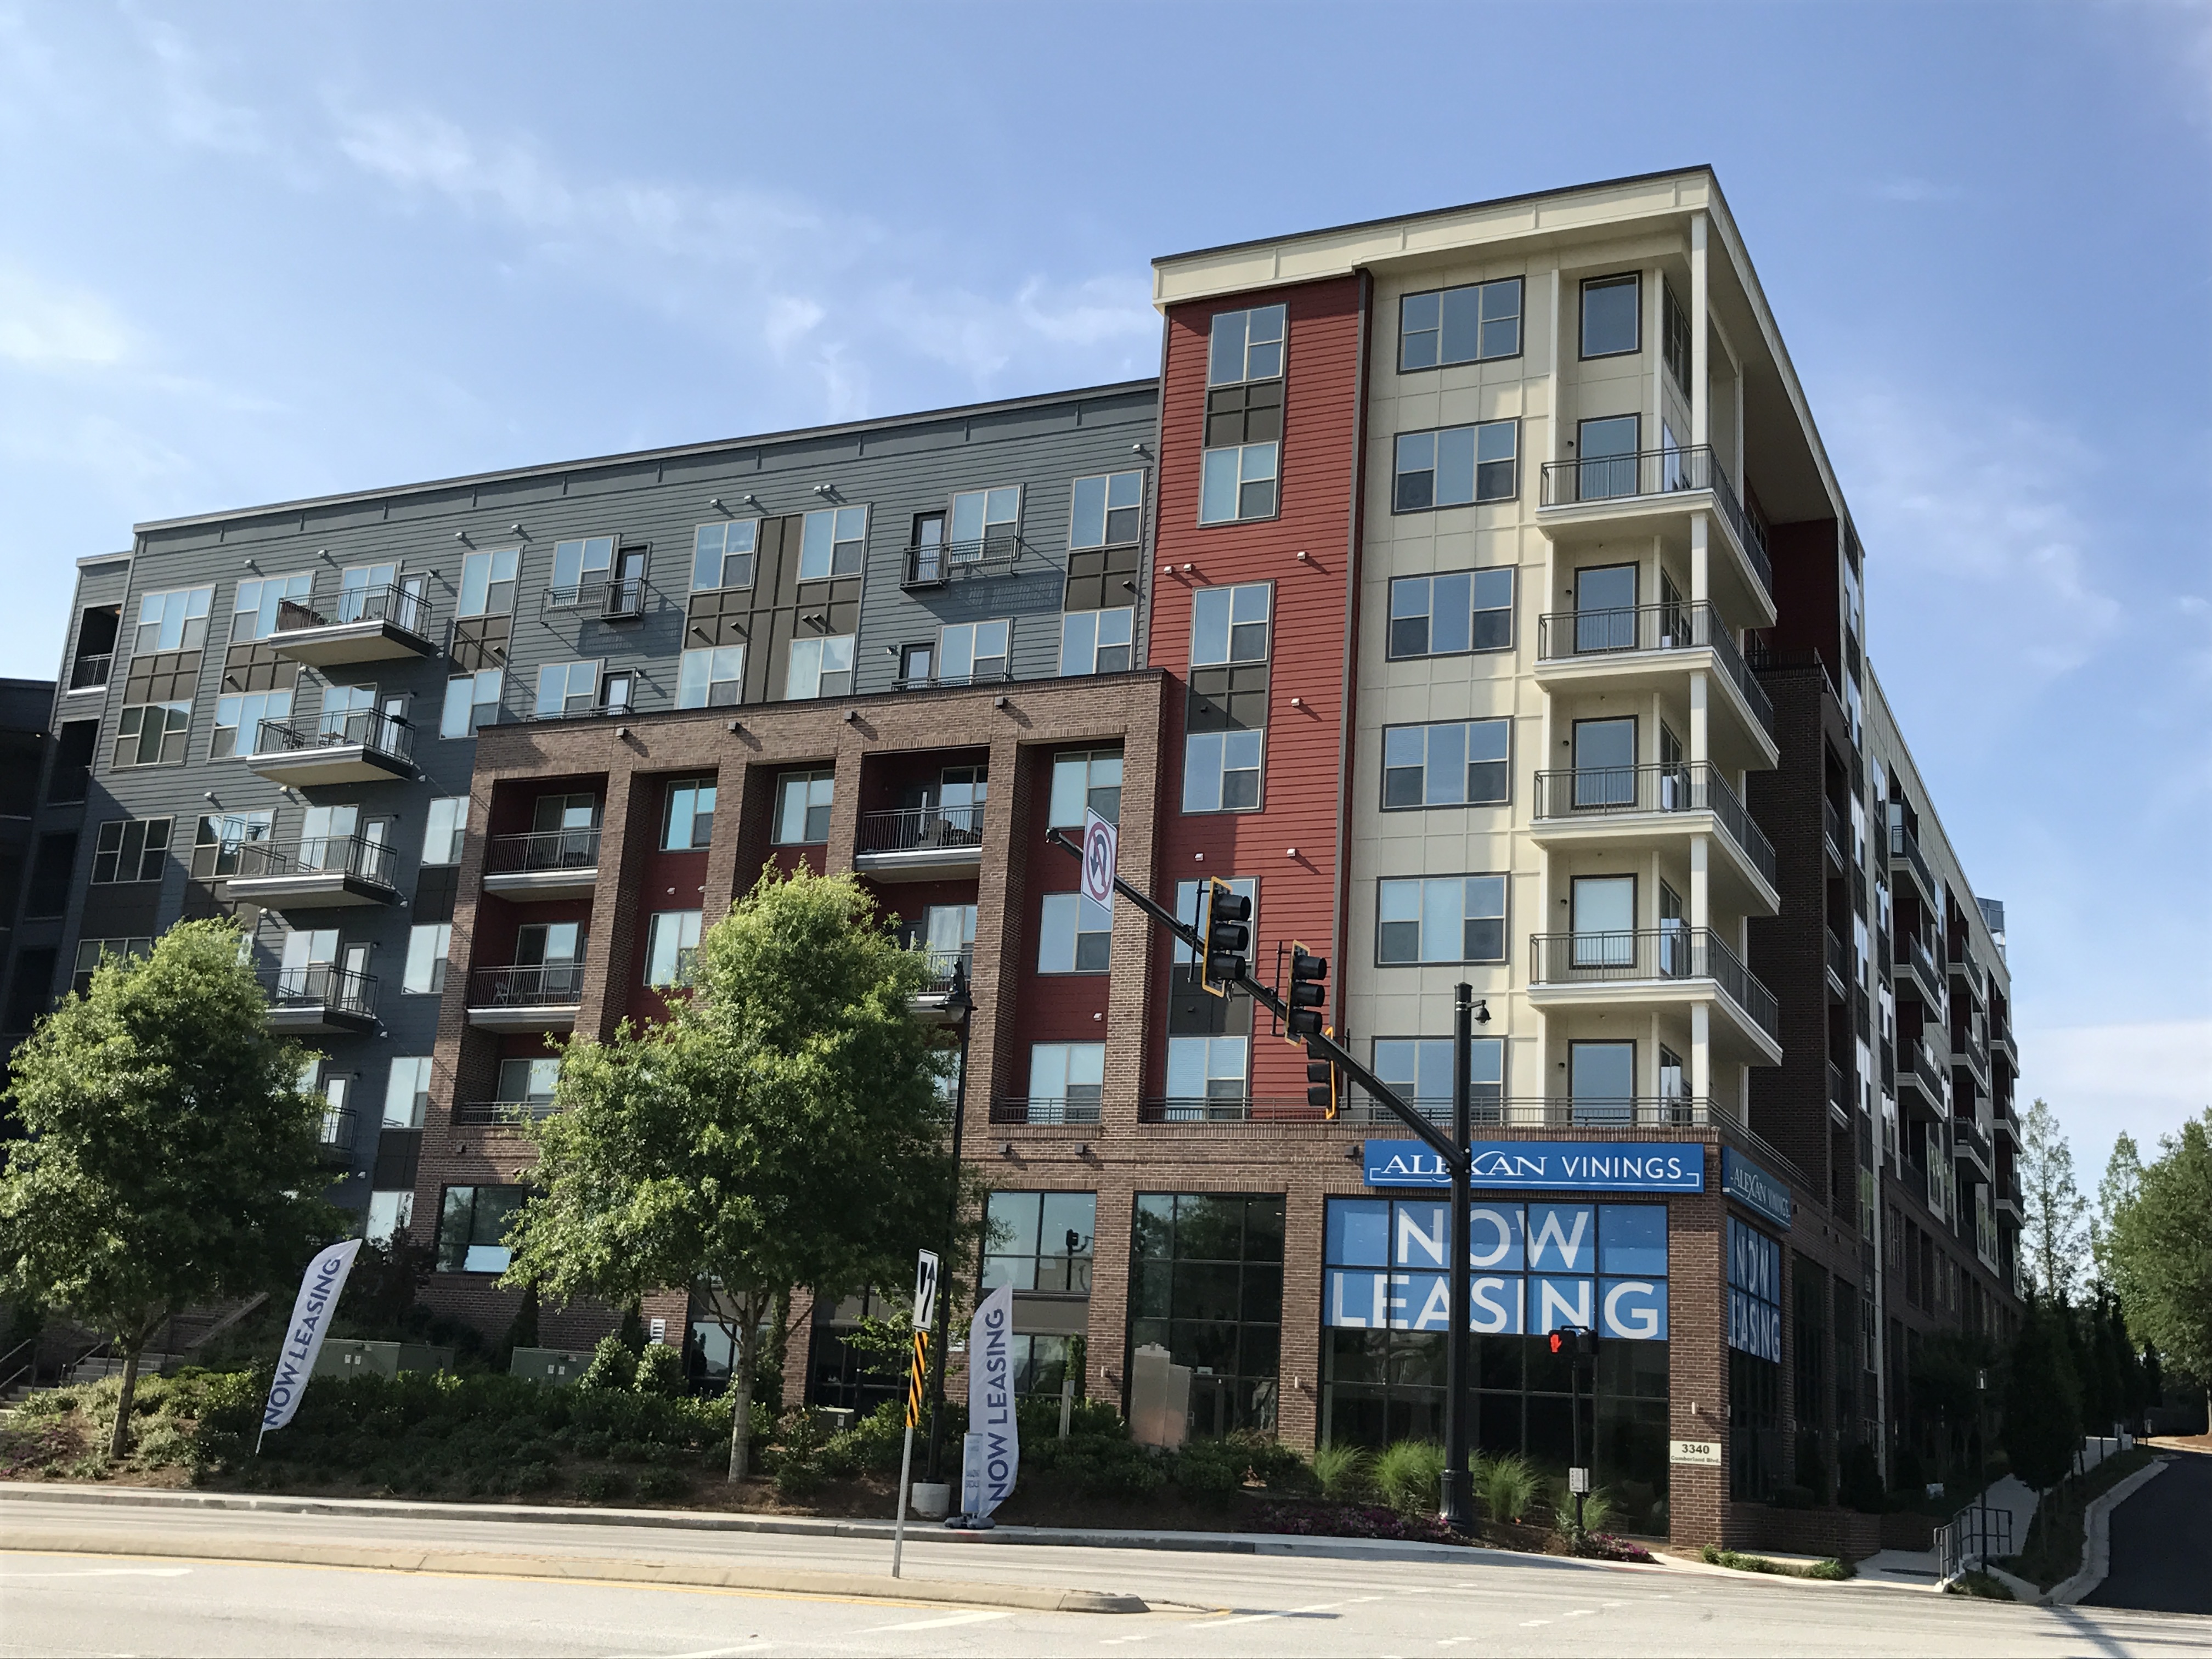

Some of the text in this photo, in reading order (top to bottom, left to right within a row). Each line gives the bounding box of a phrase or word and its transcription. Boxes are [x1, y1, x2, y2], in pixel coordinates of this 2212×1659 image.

[1561, 1156, 1681, 1179] VININGS
[1734, 1167, 1767, 1204] ALEXAN
[1397, 1207, 1588, 1269] NOW
[1333, 1272, 1658, 1339] LEASING
[263, 1259, 341, 1425] NOW LEASING
[985, 1308, 1008, 1501] NOW LEASING
[1681, 1444, 1709, 1454] 3340
